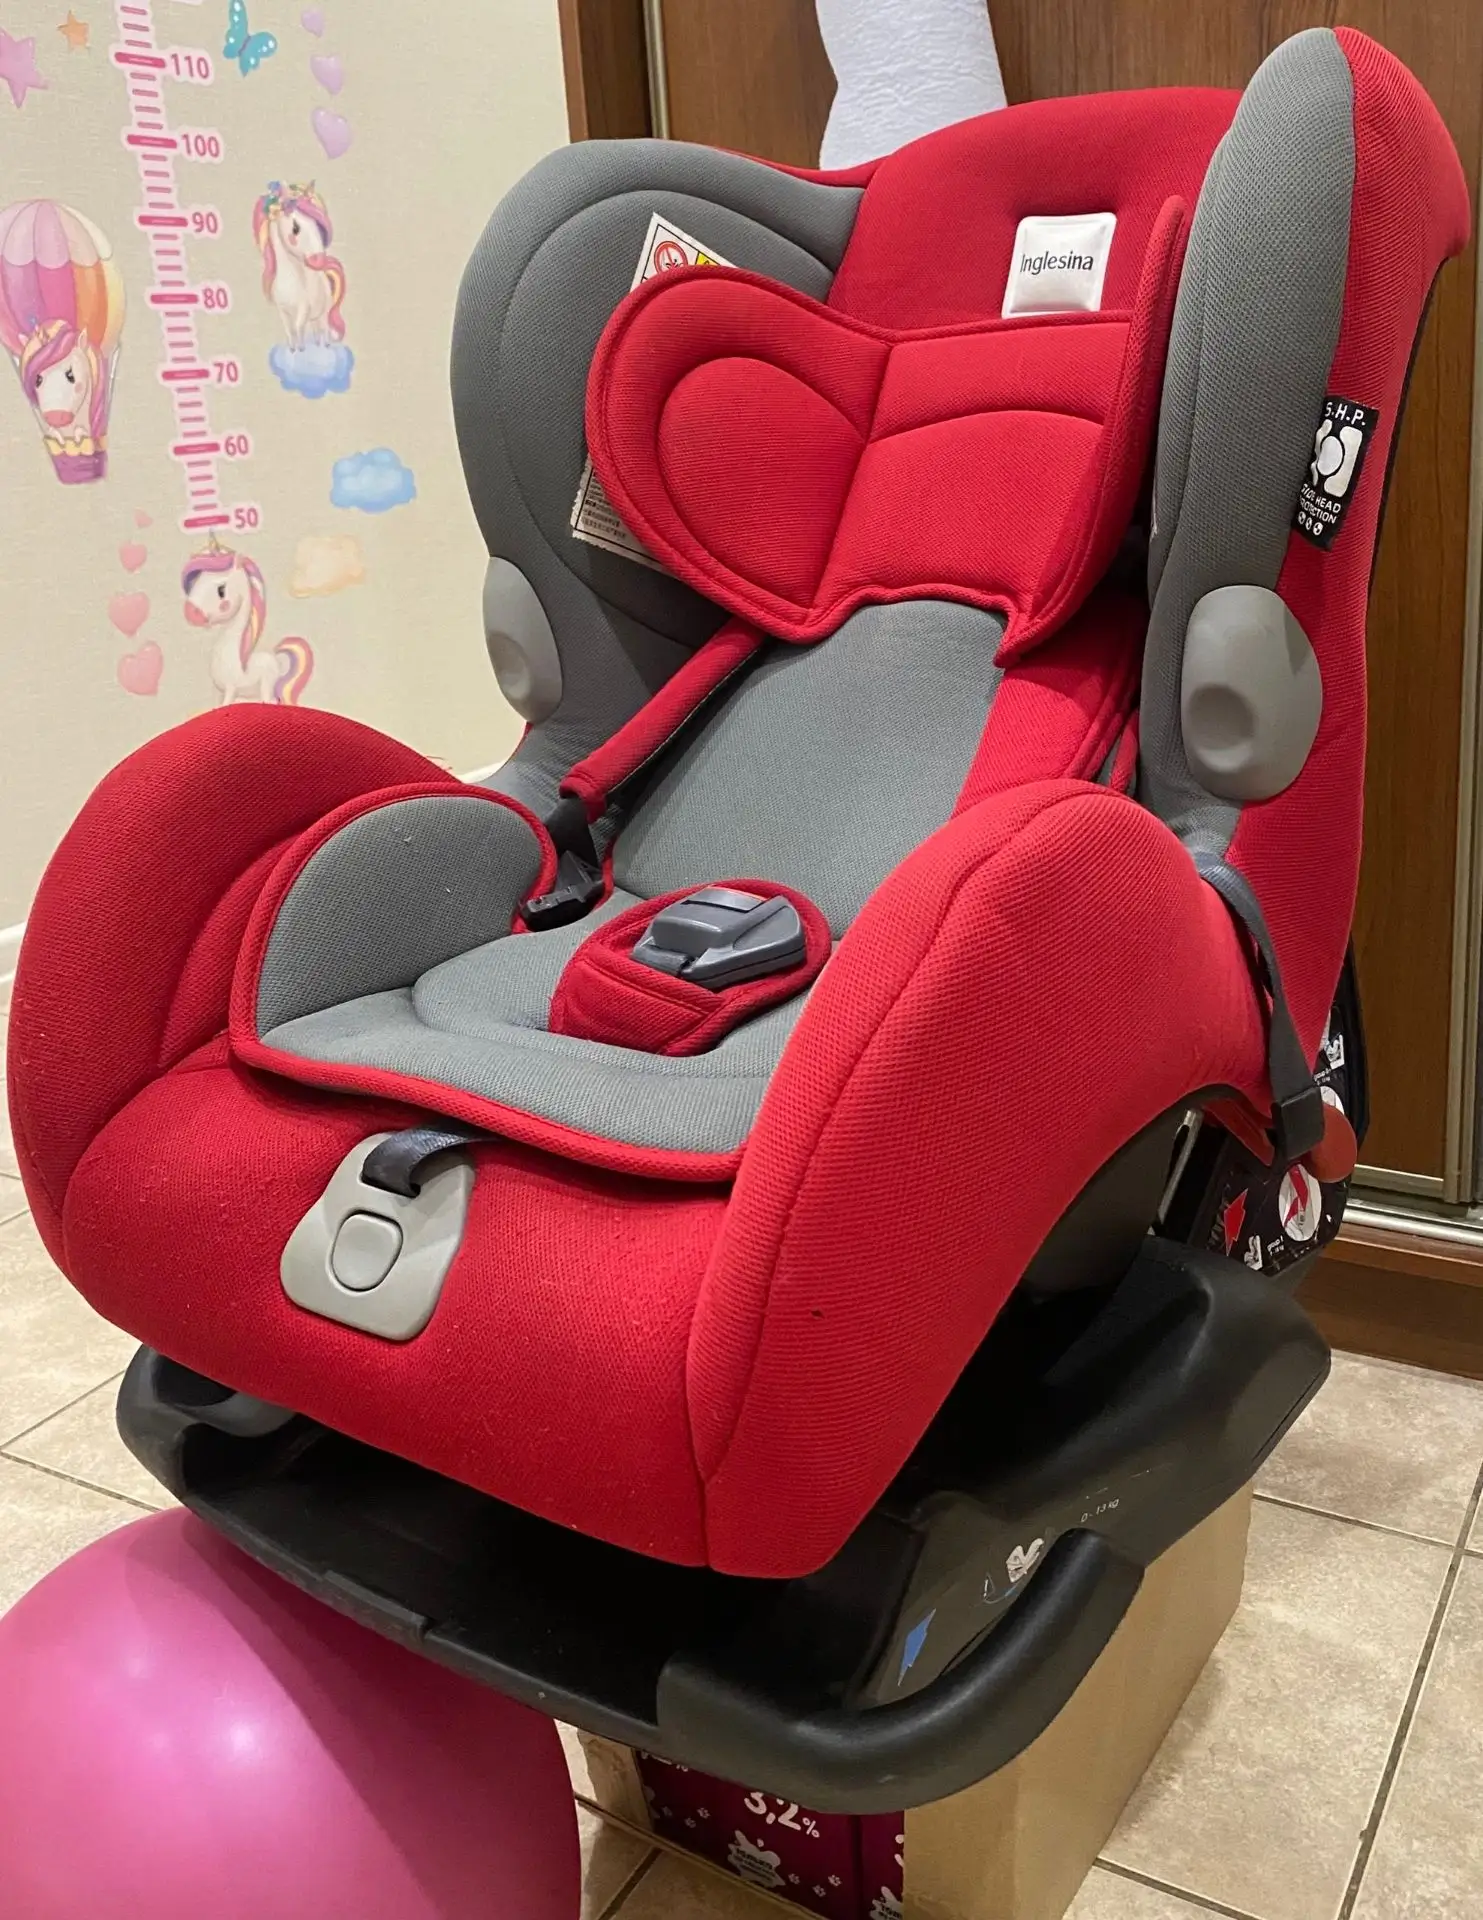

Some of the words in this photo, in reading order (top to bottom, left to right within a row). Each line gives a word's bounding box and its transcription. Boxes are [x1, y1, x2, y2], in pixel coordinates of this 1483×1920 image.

[170, 53, 210, 79] 110
[181, 134, 220, 158] 100
[192, 211, 219, 234] 90
[1020, 251, 1094, 276] Inglesina
[202, 287, 228, 309] 80
[213, 361, 239, 383] 70
[224, 434, 249, 457] 60
[1315, 496, 1341, 513] HEAD
[234, 507, 259, 529] 50
